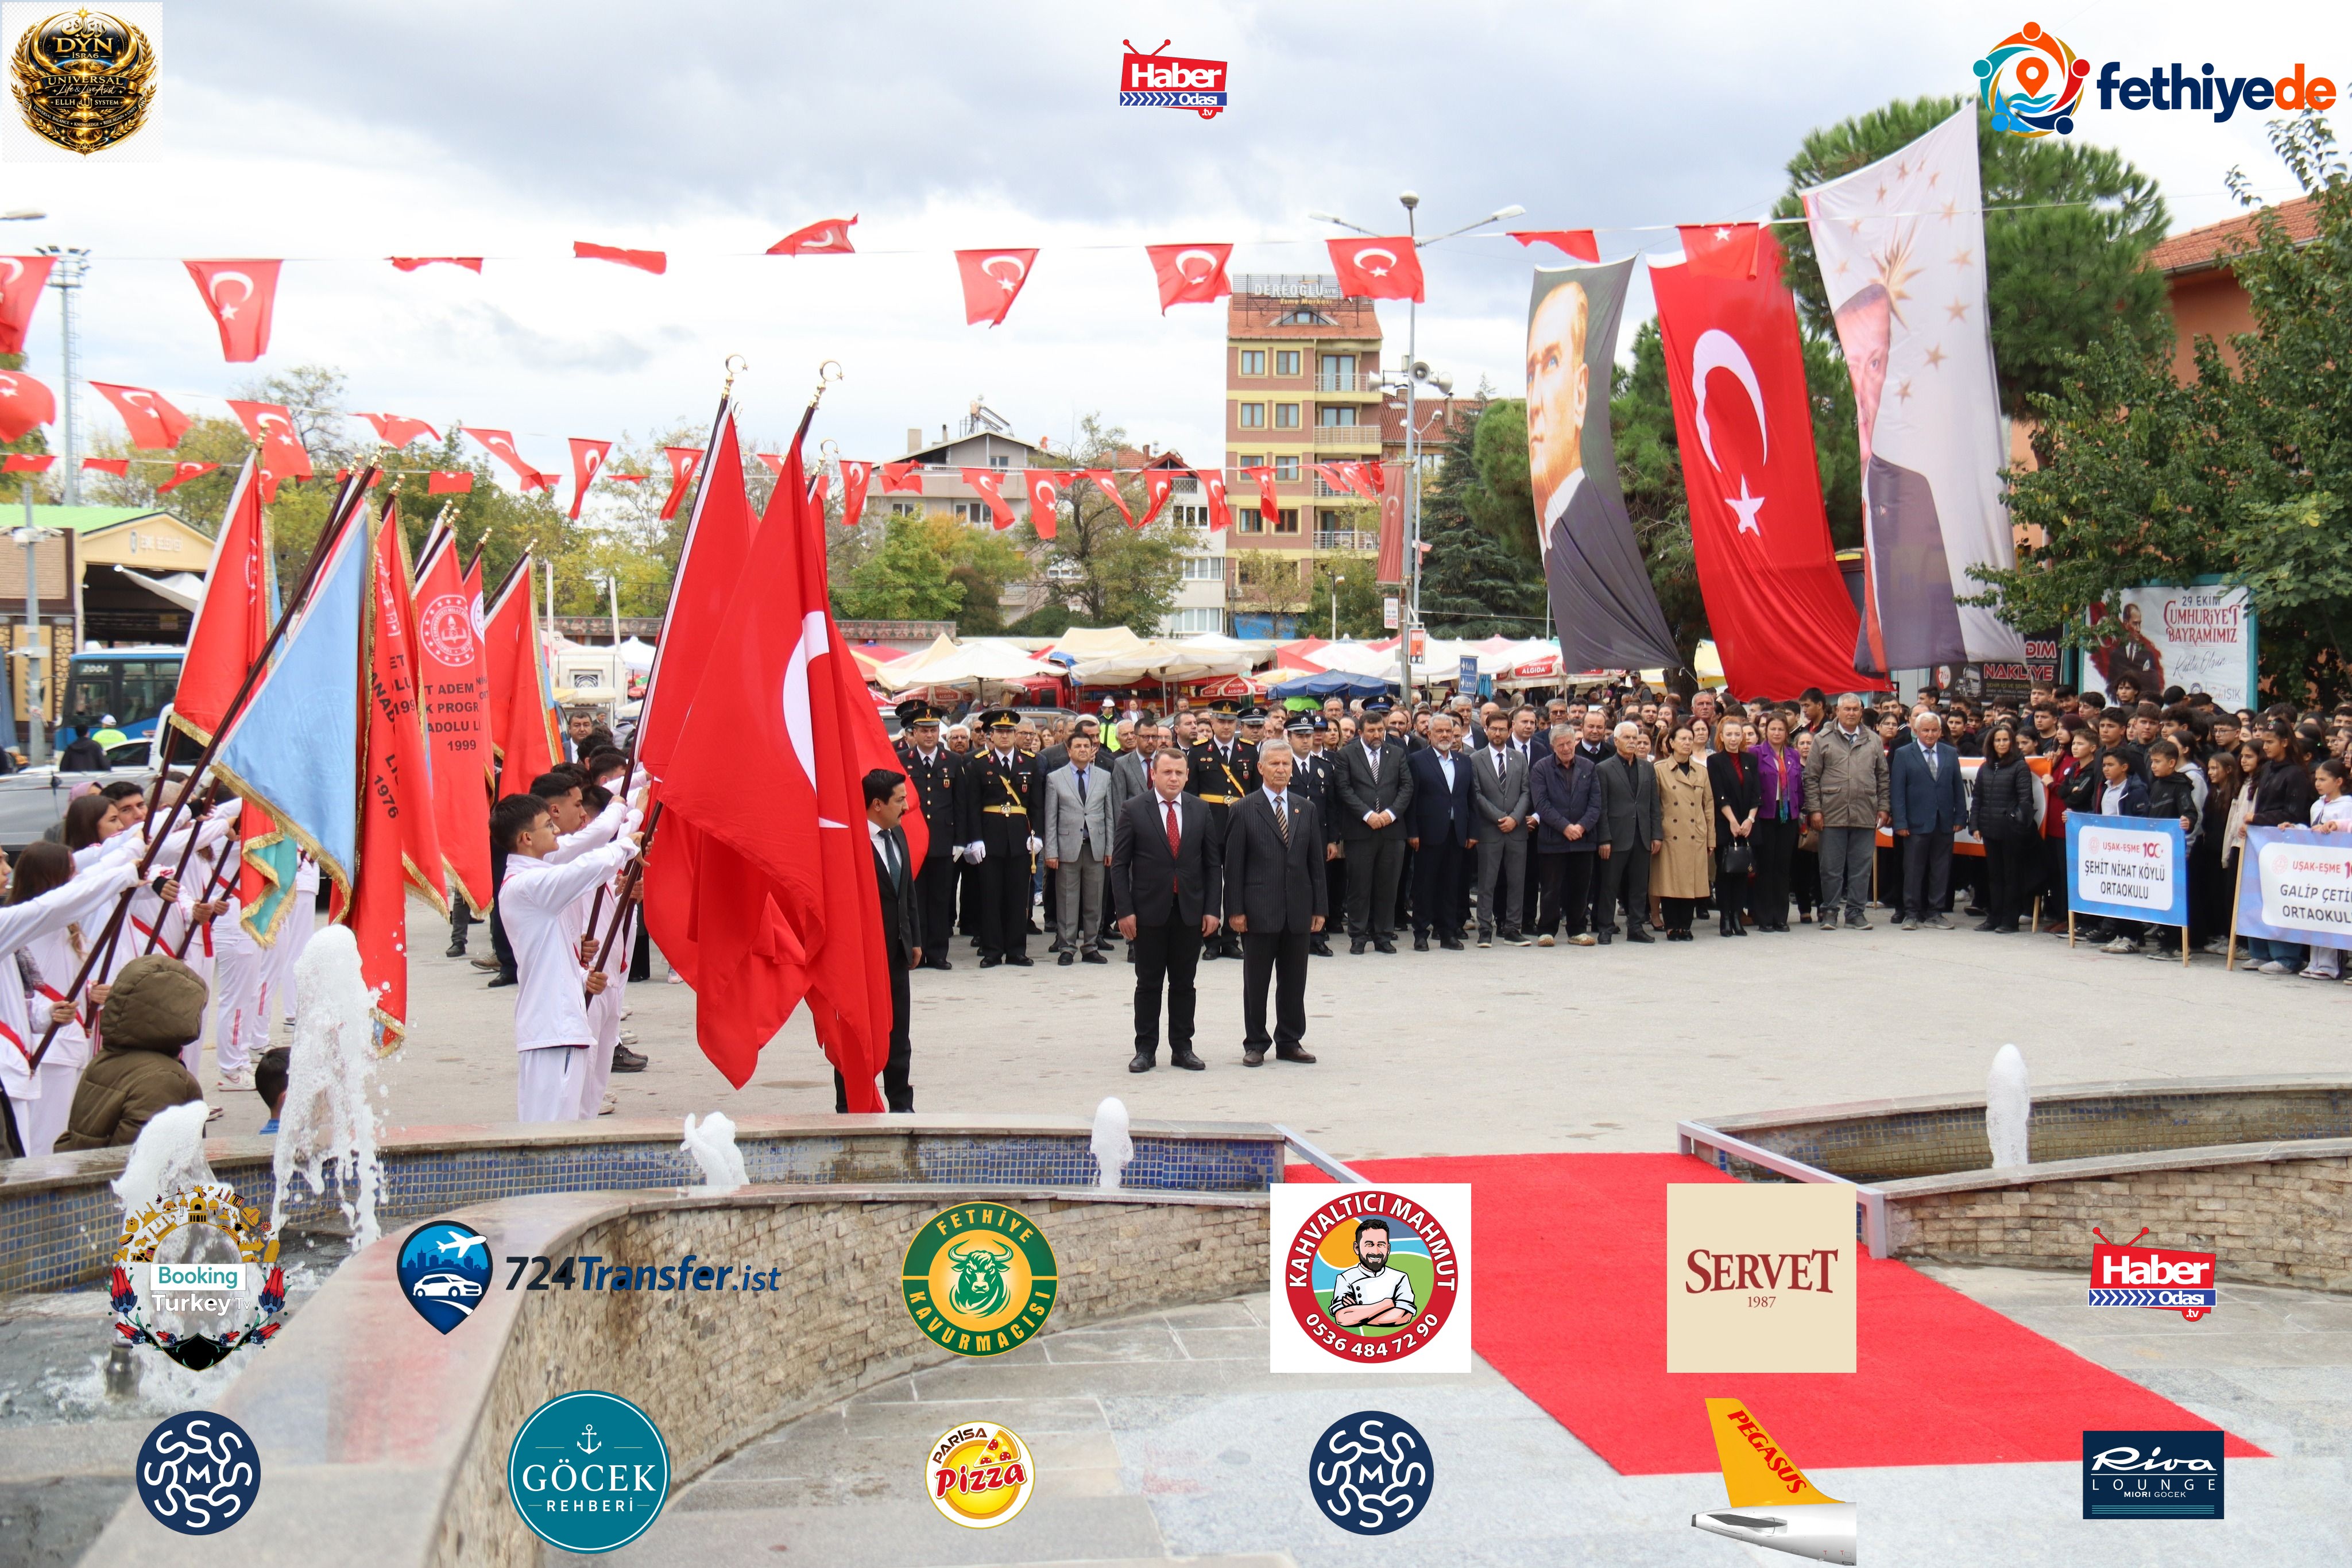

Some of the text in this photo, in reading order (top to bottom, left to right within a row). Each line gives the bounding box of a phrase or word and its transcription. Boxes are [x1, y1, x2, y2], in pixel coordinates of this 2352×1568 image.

[2181, 593, 2221, 607] 29 EKİM
[2164, 601, 2241, 628] CUMHURİYET
[2166, 628, 2238, 646] BAYRAMIMIZ
[1465, 663, 1475, 671] Kula
[1521, 667, 1546, 675] ALGIDA
[438, 683, 474, 695] ADEM
[447, 740, 476, 751] 1999
[374, 775, 399, 819] 1976
[2103, 842, 2140, 854] UŞAK-EŞME
[2084, 858, 2165, 881] ŞEHİT NİHAT KÖYLÜ
[2293, 861, 2341, 874] UŞAK-EŞME
[2100, 881, 2149, 899] ORTAOKULU
[2280, 883, 2352, 903] GALİP ÇETİ
